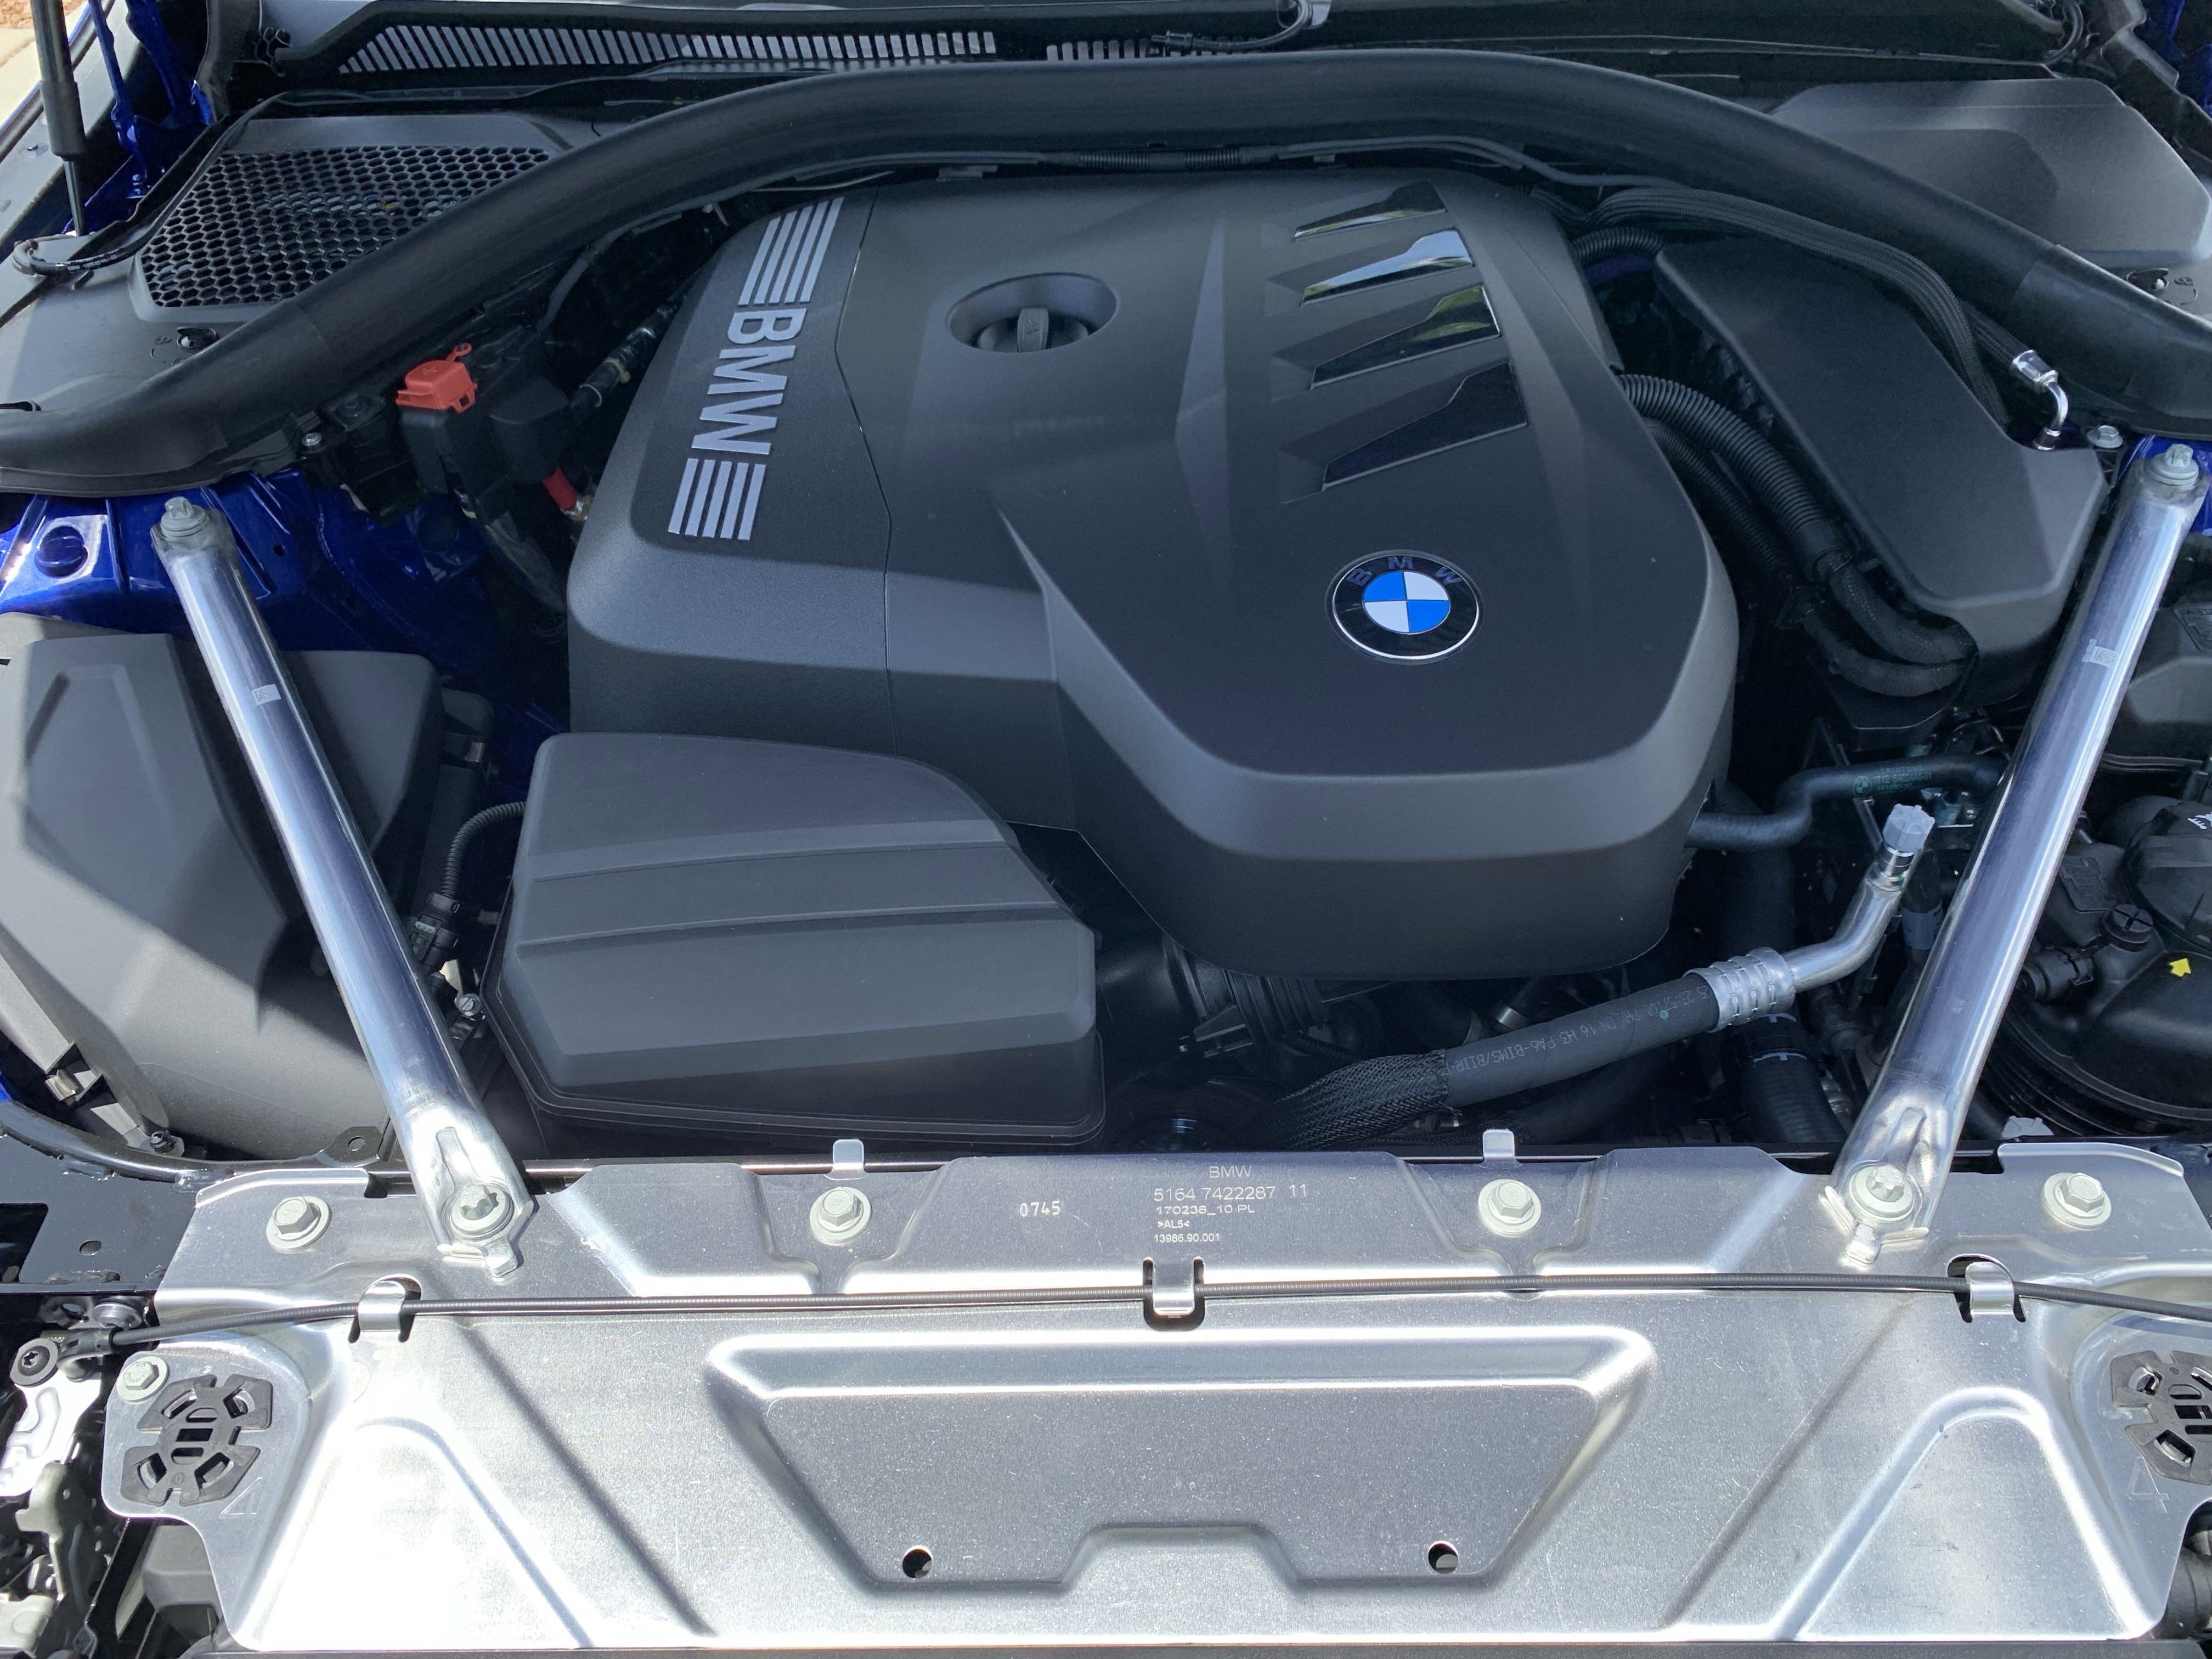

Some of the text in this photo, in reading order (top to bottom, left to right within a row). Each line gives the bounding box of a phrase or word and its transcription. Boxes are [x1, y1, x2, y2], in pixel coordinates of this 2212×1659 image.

[692, 308, 806, 454] BMW
[1346, 556, 1462, 586] BMW
[1209, 1165, 1252, 1179] BMW
[1154, 1183, 1307, 1202] 5164 7422287 11
[1019, 1198, 1060, 1217] 0745
[1237, 1204, 1255, 1214] PL
[1154, 1233, 1220, 1243] 13986.90.001
